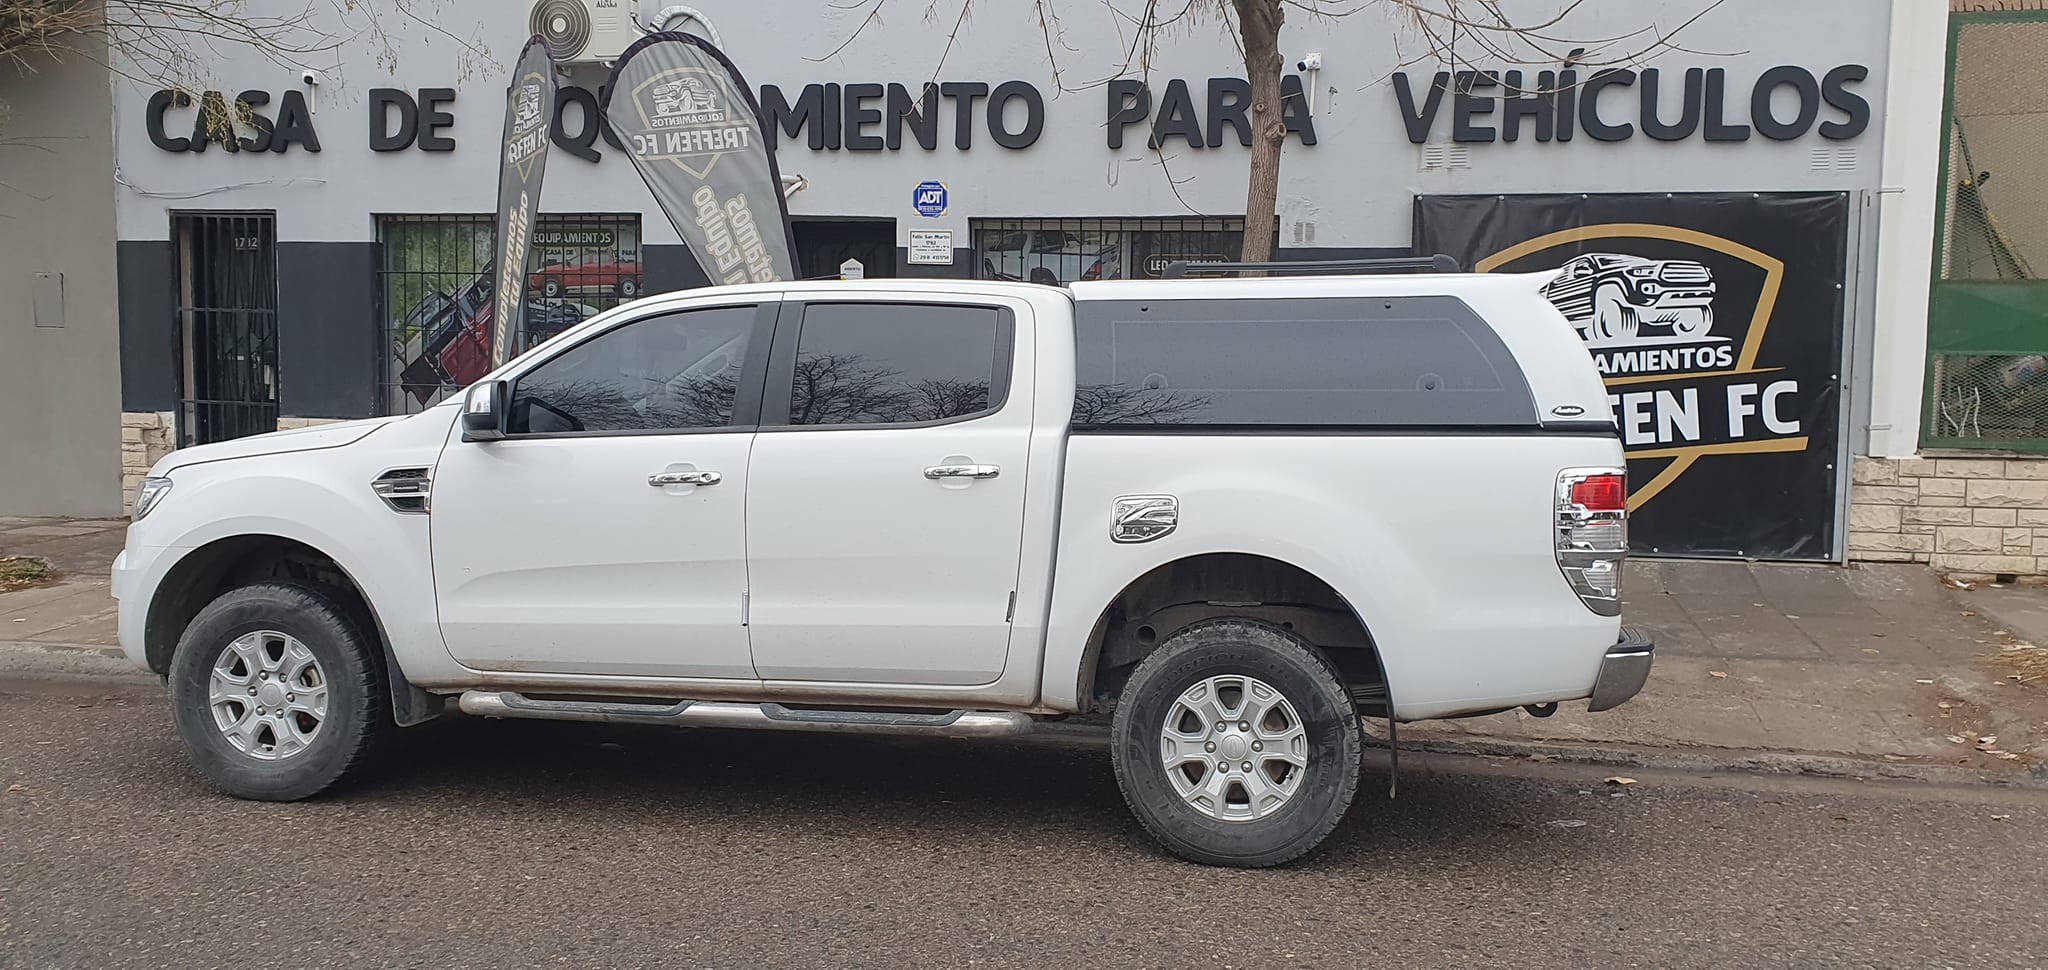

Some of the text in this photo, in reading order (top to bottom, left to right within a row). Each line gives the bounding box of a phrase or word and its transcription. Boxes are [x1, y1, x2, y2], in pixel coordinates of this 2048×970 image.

[146, 88, 321, 152] CASA
[369, 88, 456, 151] DE
[1107, 74, 1317, 149] PARA
[1391, 48, 1871, 144] VEHÍCULOS
[919, 191, 943, 204] ADT
[533, 232, 611, 243] EQUIPAMIENTOS
[1150, 260, 1169, 271] LED
[1594, 345, 1733, 374] AMIENTOS
[1727, 380, 1800, 438] FC
